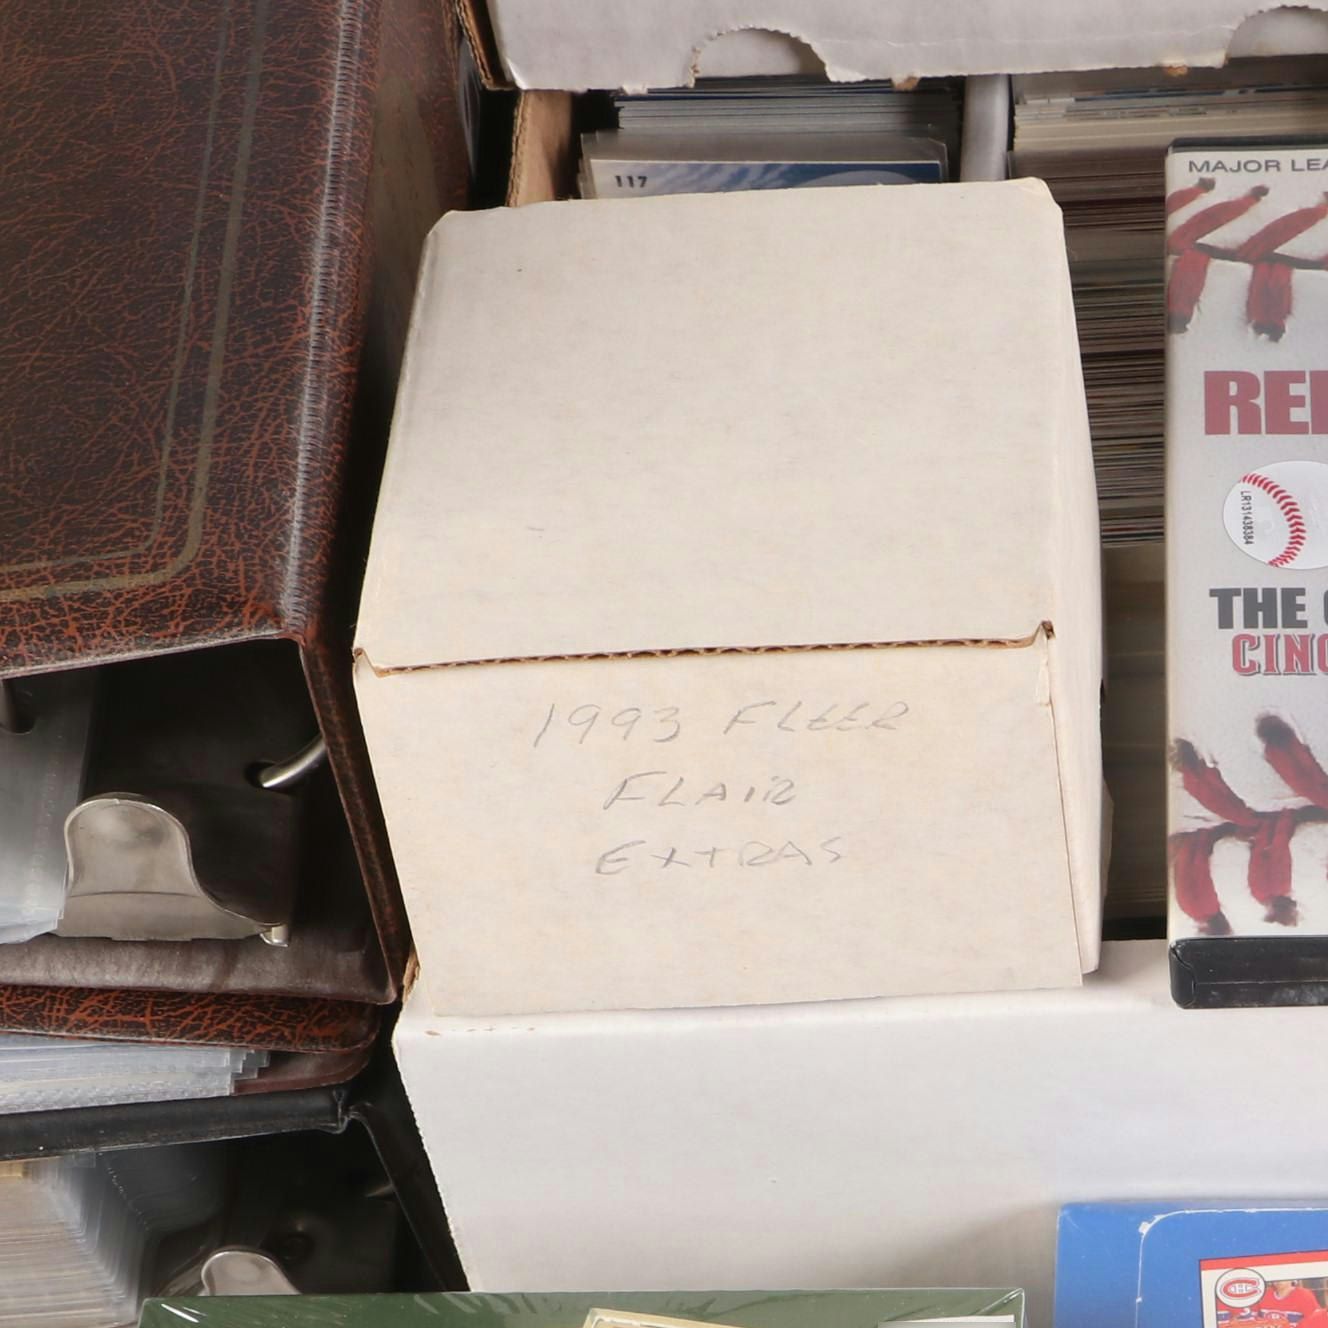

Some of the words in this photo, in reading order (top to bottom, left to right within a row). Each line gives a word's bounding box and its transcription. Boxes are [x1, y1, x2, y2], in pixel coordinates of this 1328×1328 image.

[614, 174, 648, 189] 117
[1188, 158, 1282, 174] MAJOR
[1209, 587, 1309, 629] THE
[532, 701, 683, 749] 1993
[593, 835, 845, 877] EXTRAS
